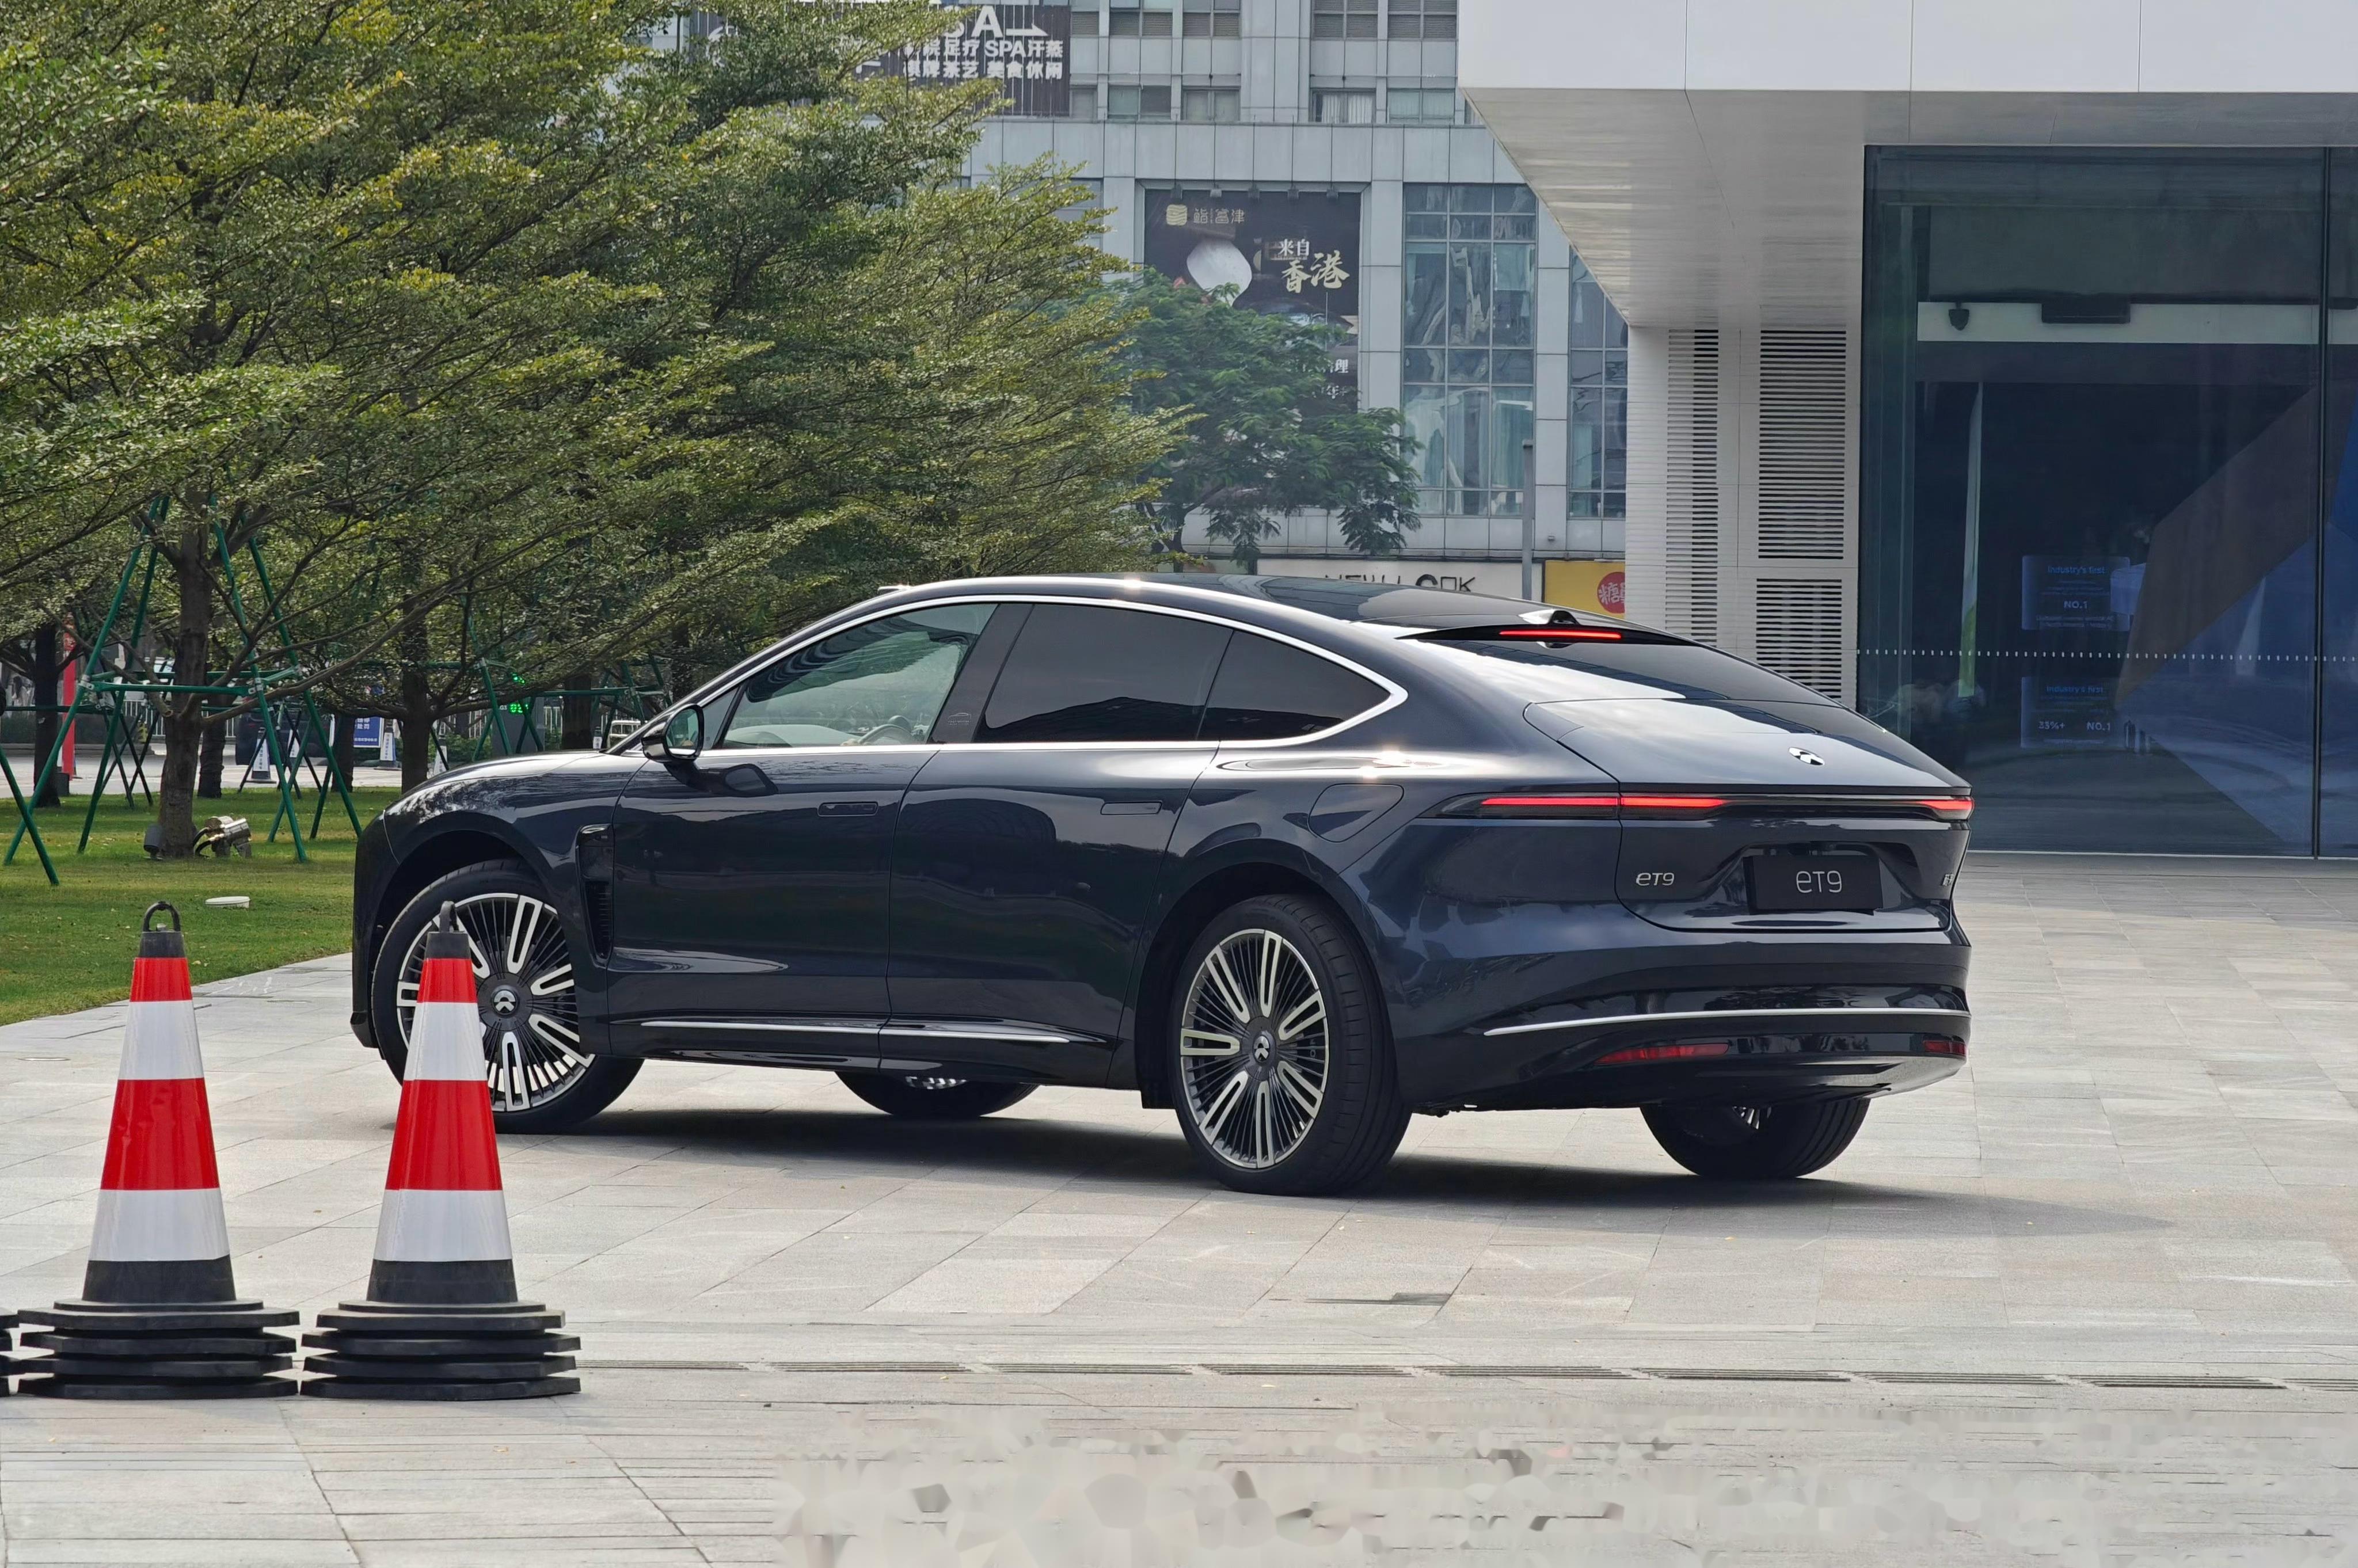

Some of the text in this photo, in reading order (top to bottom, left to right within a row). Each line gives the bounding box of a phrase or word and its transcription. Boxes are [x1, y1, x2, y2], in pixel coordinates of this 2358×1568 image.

[1277, 238, 1310, 257] 来自
[1280, 250, 1350, 294] 香港
[2063, 600, 2087, 609] NO.1
[2086, 721, 2110, 730] NO.1
